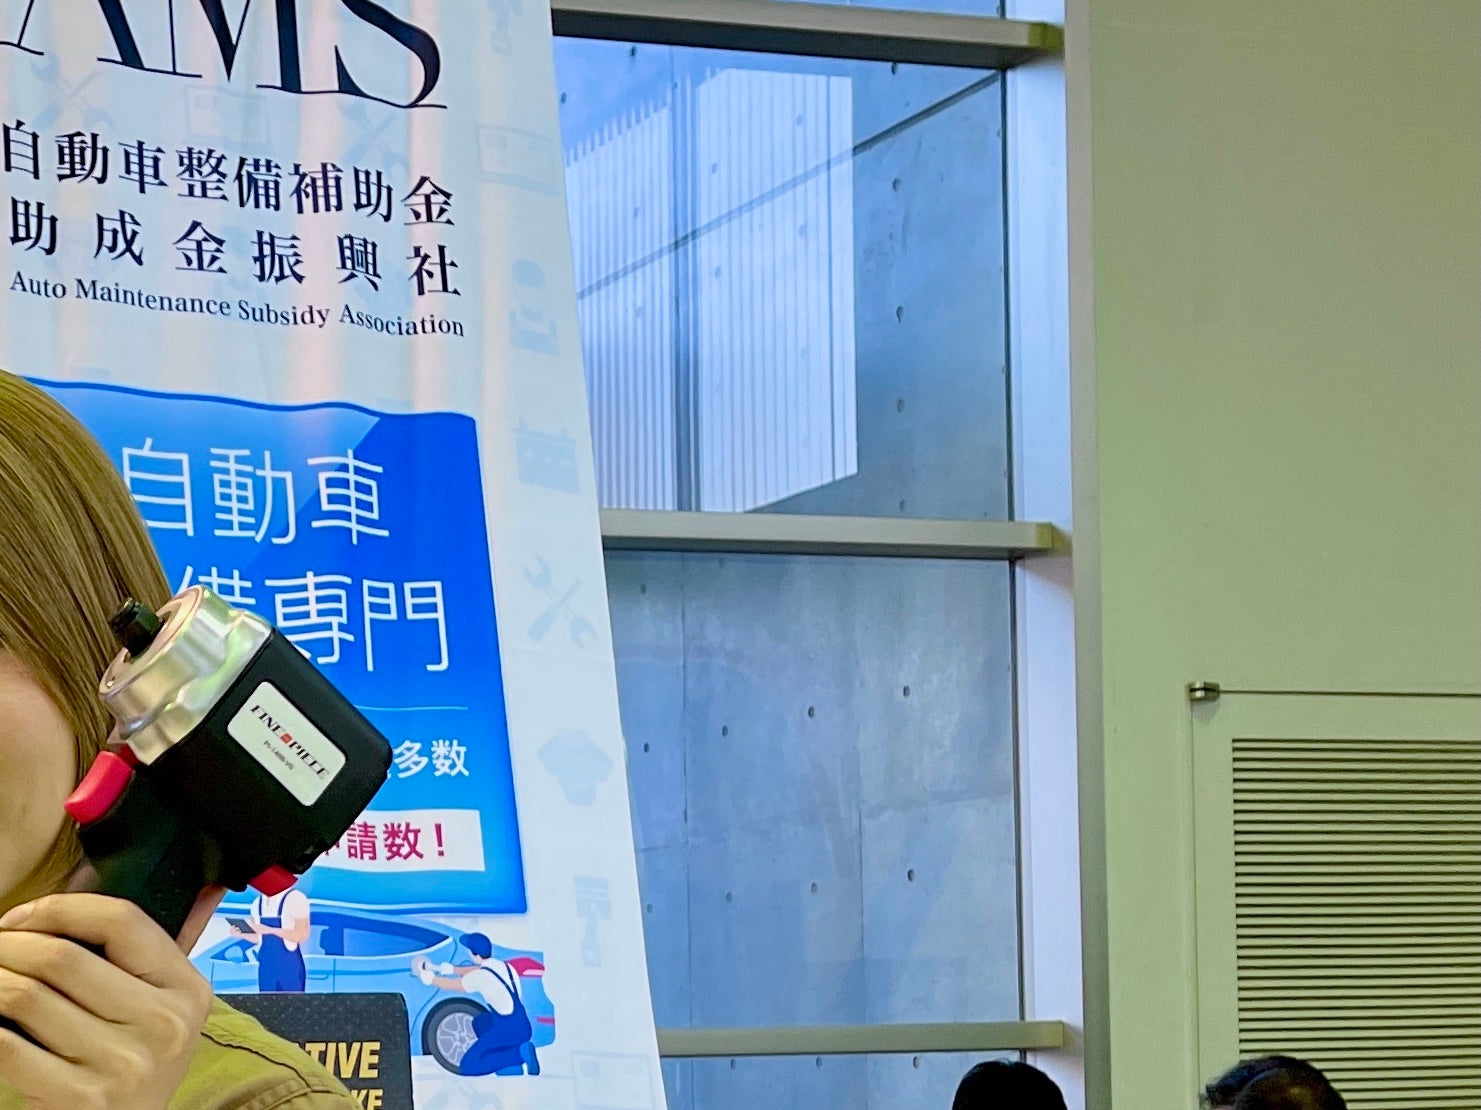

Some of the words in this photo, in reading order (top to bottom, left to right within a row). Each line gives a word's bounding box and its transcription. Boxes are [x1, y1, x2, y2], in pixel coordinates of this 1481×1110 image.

[2, 119, 455, 228] 自動車整備補助金
[10, 196, 461, 297] 助成金振興社
[10, 271, 67, 299] Auto
[75, 278, 231, 317] Maintenance
[237, 301, 328, 328] Subsidy
[339, 304, 465, 337] Association
[122, 437, 390, 545] 自動車
[388, 739, 470, 779] 多数
[296, 1041, 380, 1079] TIVE
